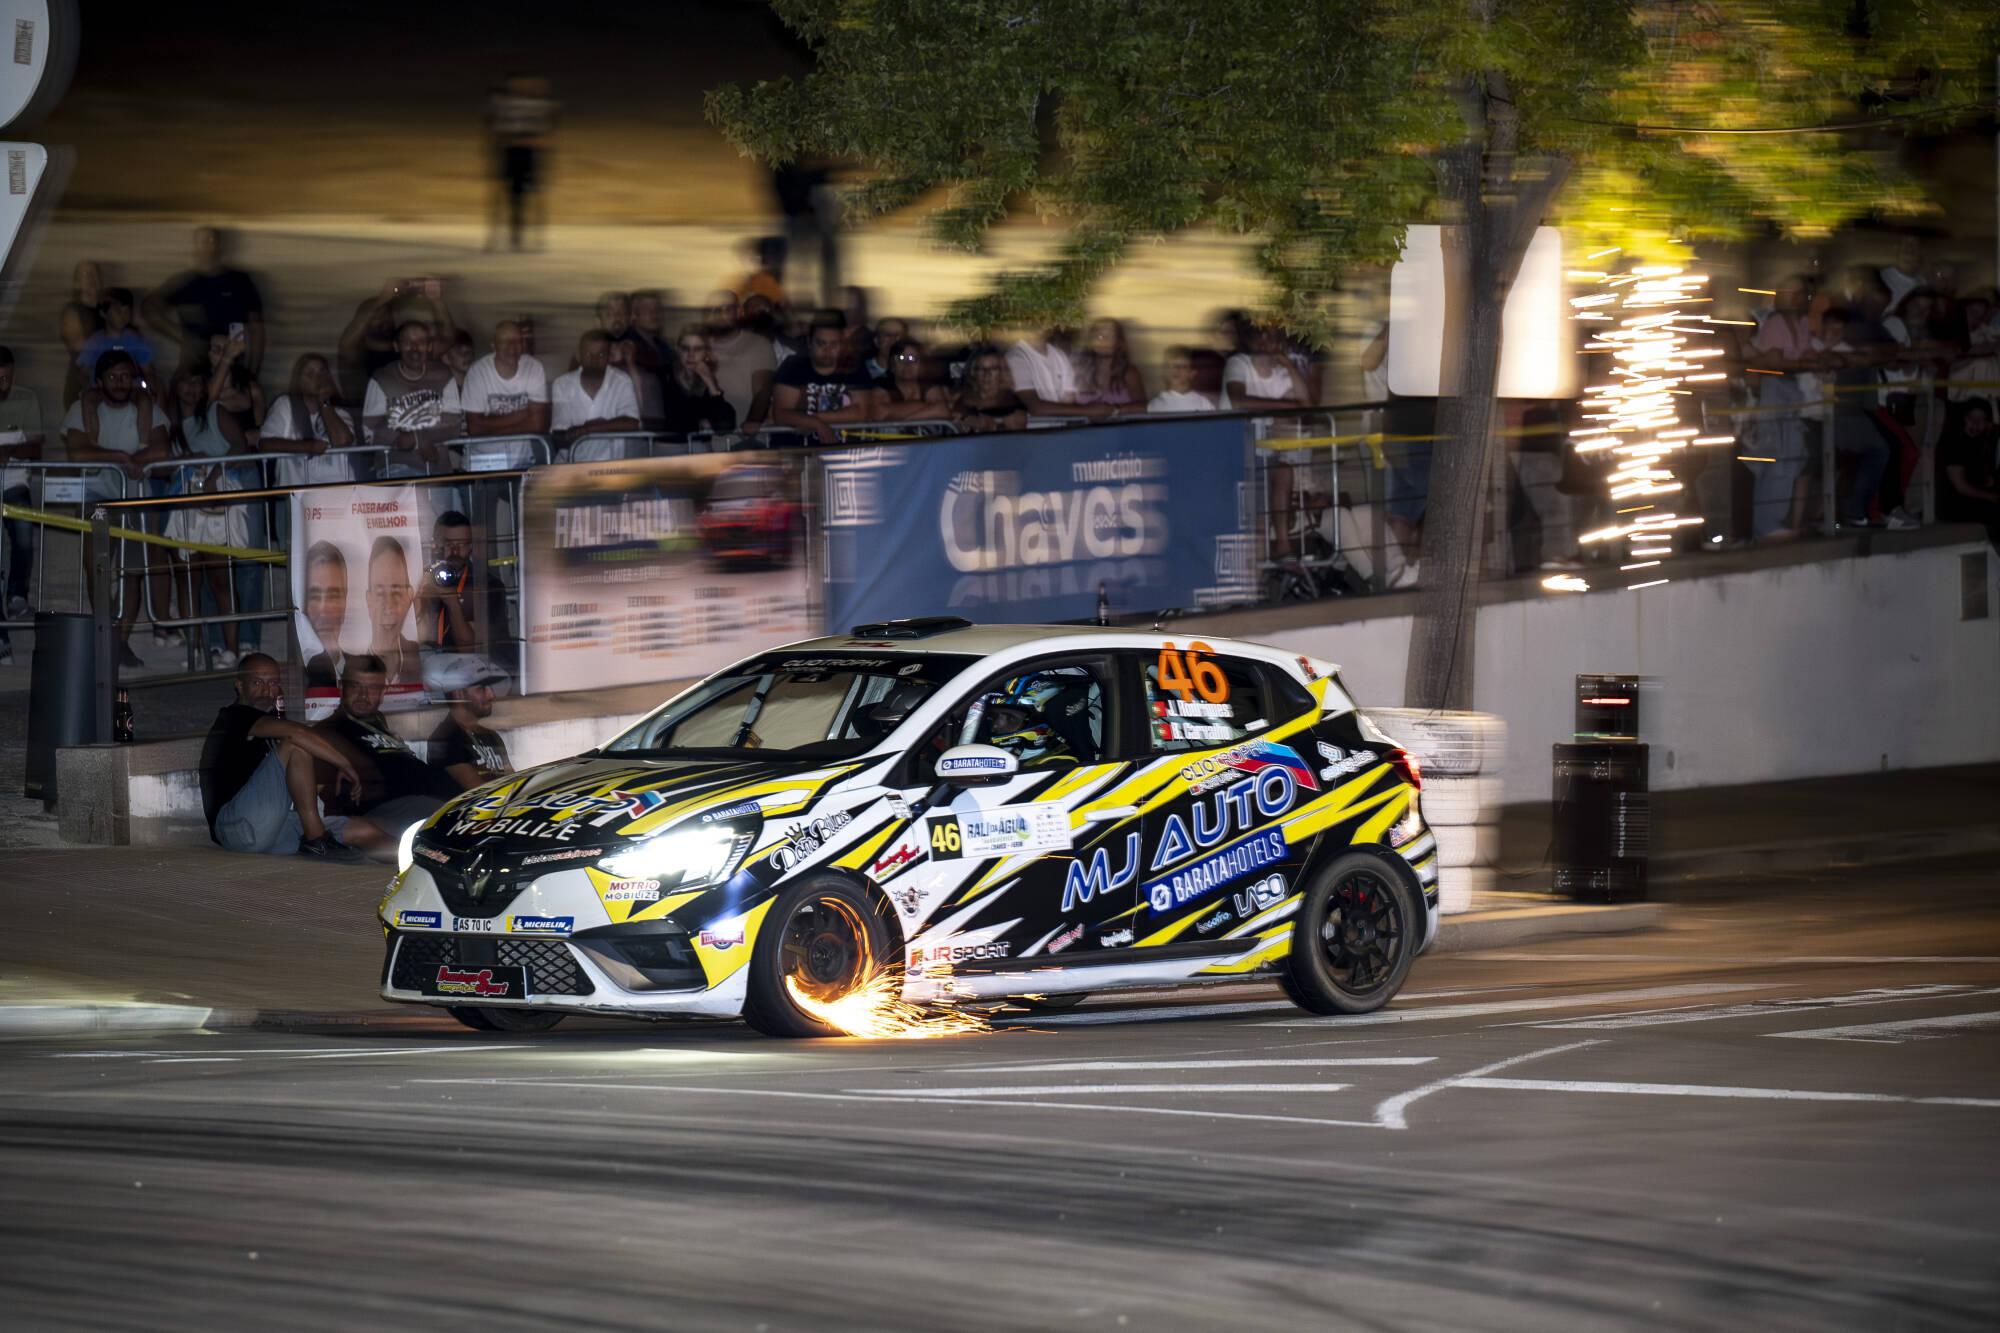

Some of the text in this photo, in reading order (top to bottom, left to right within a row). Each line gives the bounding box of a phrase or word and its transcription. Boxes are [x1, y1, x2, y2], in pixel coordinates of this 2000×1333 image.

[554, 505, 601, 548] RALI
[940, 469, 1145, 572] Chaves
[1157, 641, 1230, 704] 46
[446, 819, 583, 841] MOBILIZE
[931, 823, 961, 852] 46
[967, 822, 989, 838] RALI
[1060, 832, 1140, 912] MJ
[1150, 764, 1299, 871] AUTO
[1172, 832, 1284, 903] BARATAHOTELS
[604, 890, 659, 900] MOBILIZE
[609, 881, 658, 891] MOTRIO
[406, 915, 436, 924] MICHELIN
[523, 920, 566, 929] MICHELIN
